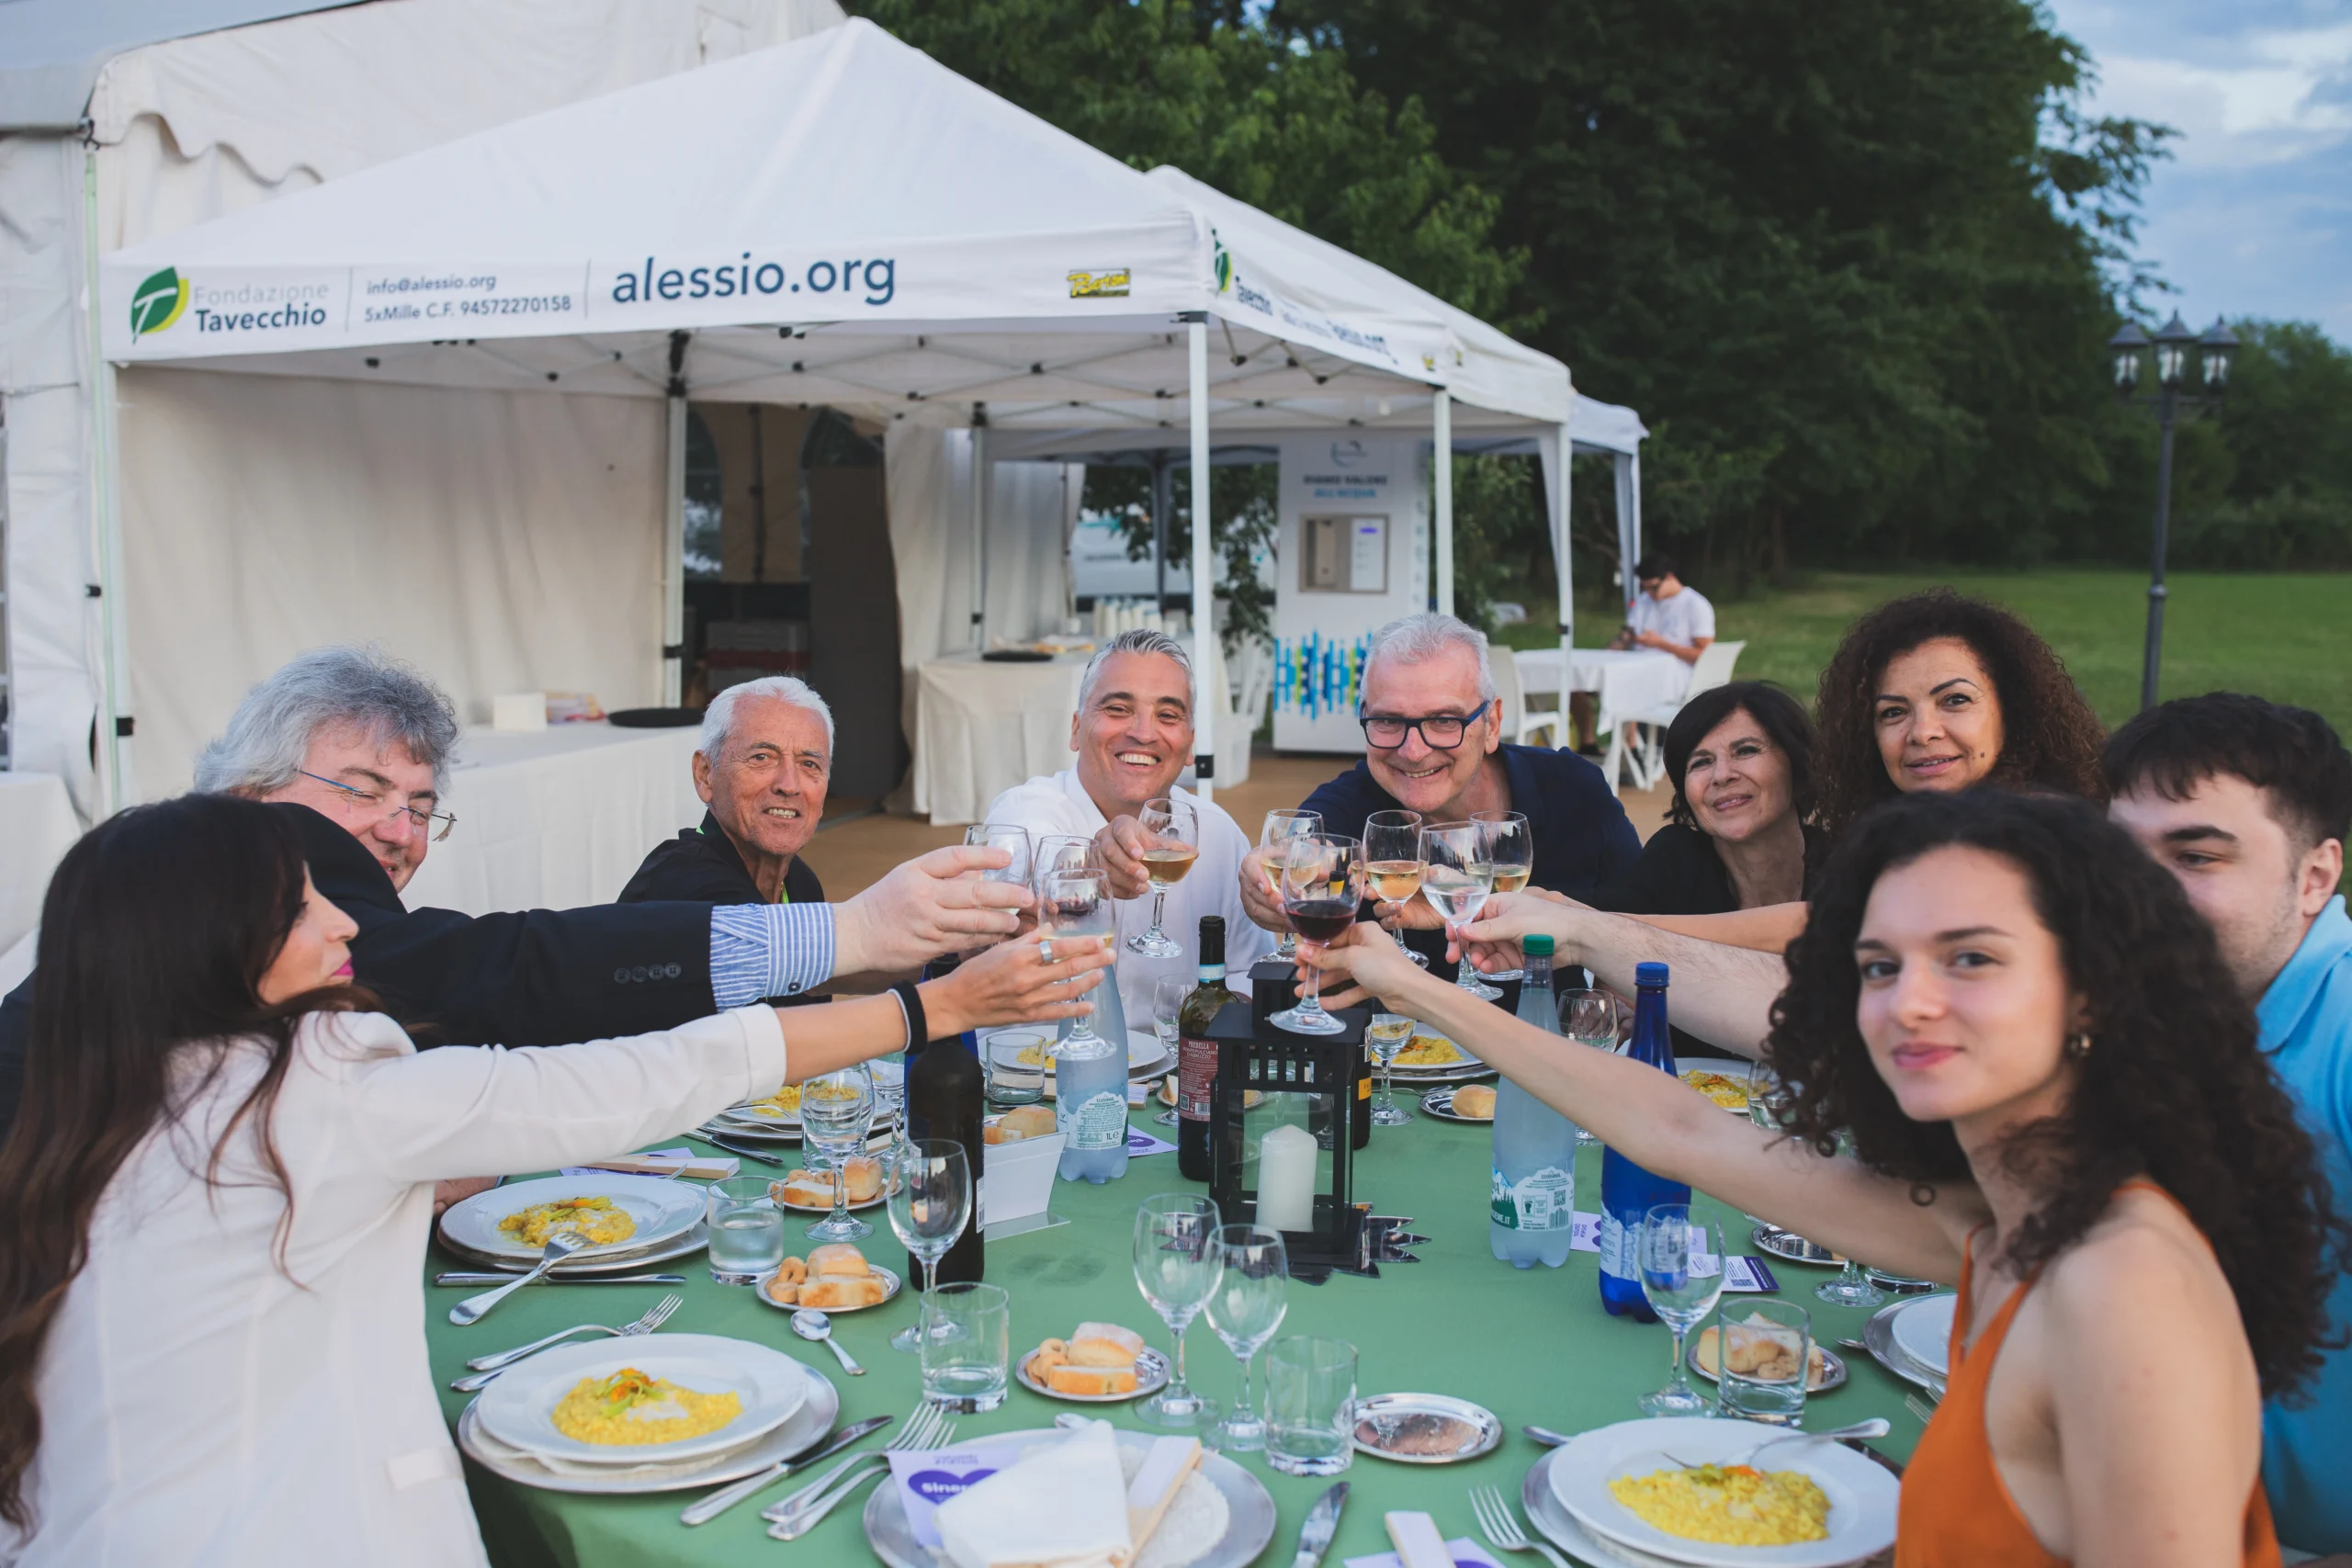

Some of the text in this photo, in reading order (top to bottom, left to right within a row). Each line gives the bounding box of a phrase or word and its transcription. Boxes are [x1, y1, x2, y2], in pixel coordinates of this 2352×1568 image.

[367, 273, 496, 296] info@alessio.org
[612, 252, 895, 306] alessio.org
[194, 282, 330, 306] Fondazione
[195, 303, 326, 333] Tavecchio
[426, 301, 455, 319] C.F.
[459, 295, 571, 316] 94572270158
